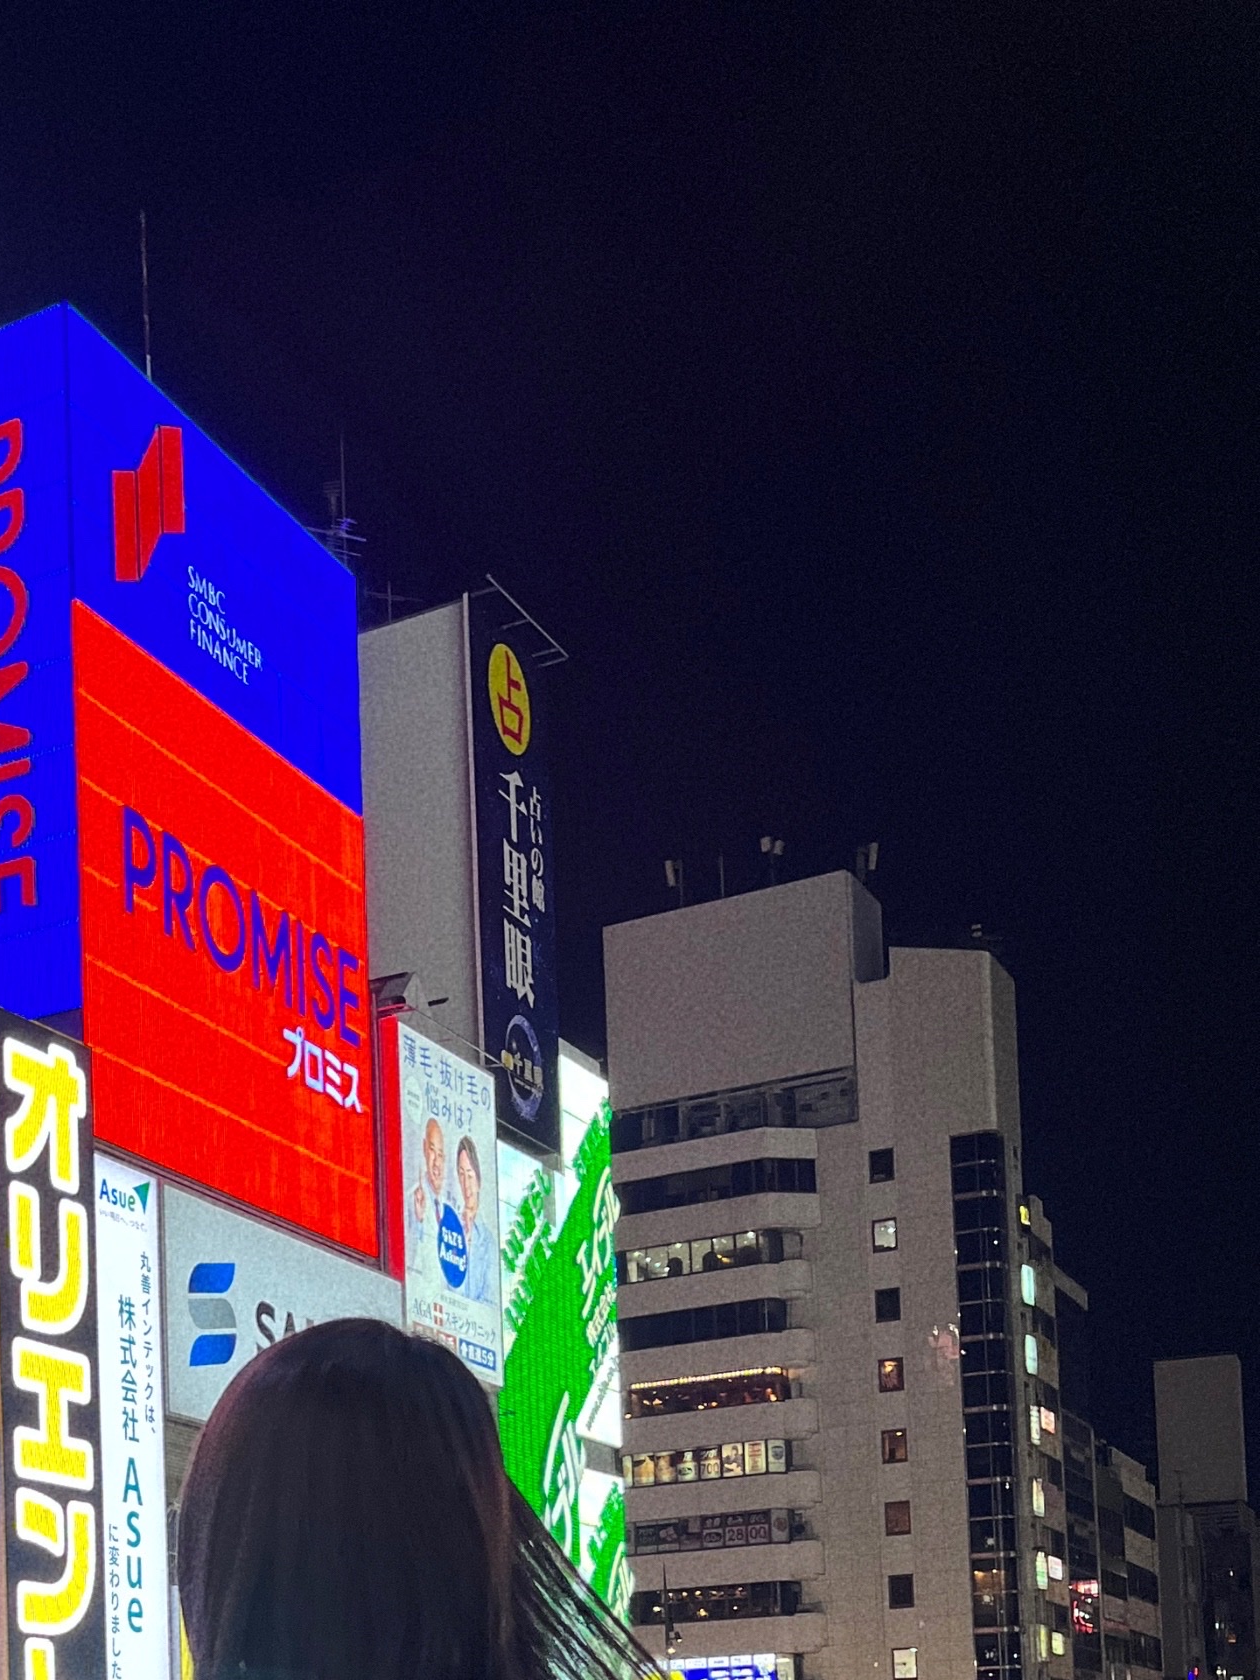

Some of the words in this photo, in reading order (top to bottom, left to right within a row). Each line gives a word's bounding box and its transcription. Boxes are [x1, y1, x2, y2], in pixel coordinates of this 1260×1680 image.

[188, 565, 225, 614] SMBC
[188, 593, 263, 672] CONSUMER
[190, 618, 249, 685] FINANCE
[498, 650, 524, 745] 占
[123, 804, 362, 1049] PROMISE
[498, 770, 535, 1008] 千里眼
[283, 1025, 363, 1113] プロミス
[99, 1178, 136, 1212] Asue
